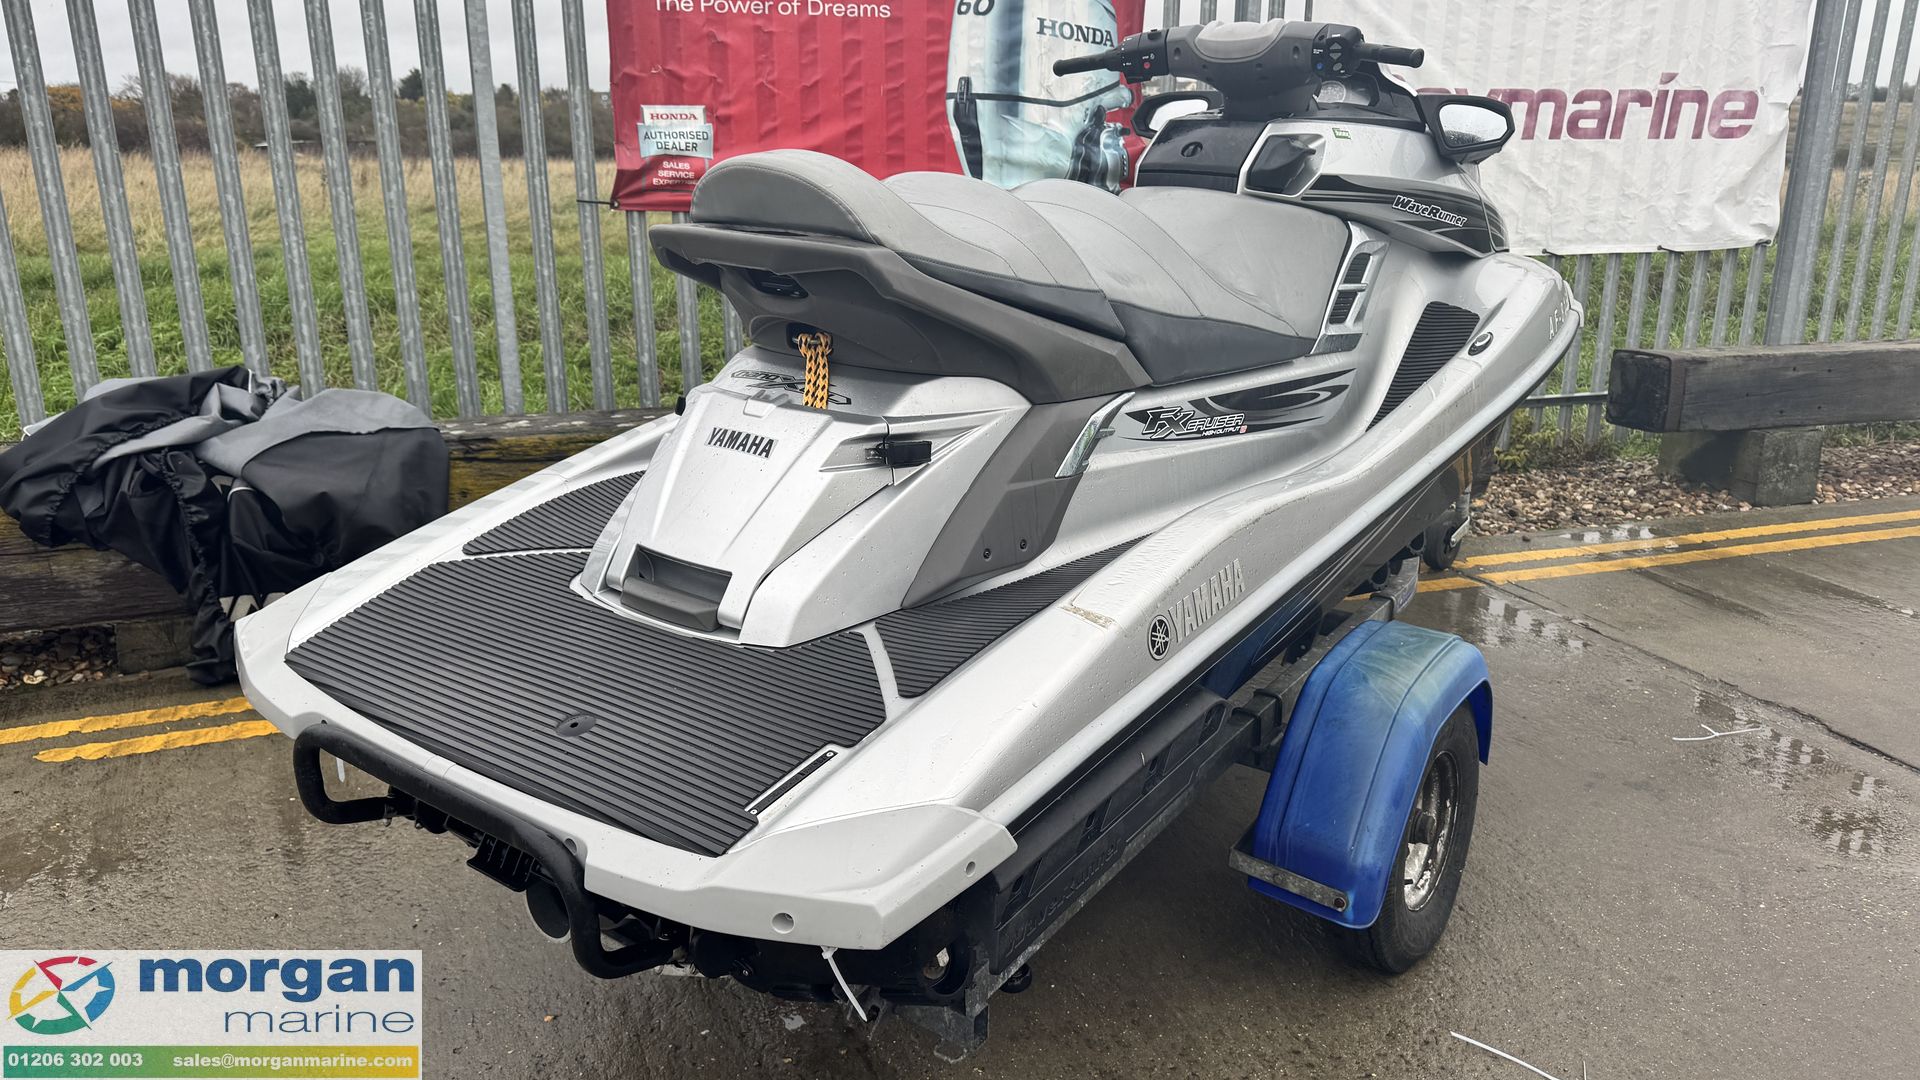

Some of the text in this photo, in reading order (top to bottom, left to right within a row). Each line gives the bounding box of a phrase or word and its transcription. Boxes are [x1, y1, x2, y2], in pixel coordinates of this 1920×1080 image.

[656, 0, 891, 18] The Power of Dreams
[1036, 17, 1115, 48] HONDA
[1392, 73, 1759, 140] marine
[643, 131, 709, 140] AUTHORISED
[656, 141, 698, 152] DEALER
[657, 169, 695, 178] SERVICE
[662, 161, 690, 170] SALES
[1392, 194, 1468, 227] WaveRunner
[1142, 405, 1244, 439] FX CRUISER
[707, 427, 775, 458] YAMAHA
[1168, 558, 1245, 643] YAMAHA
